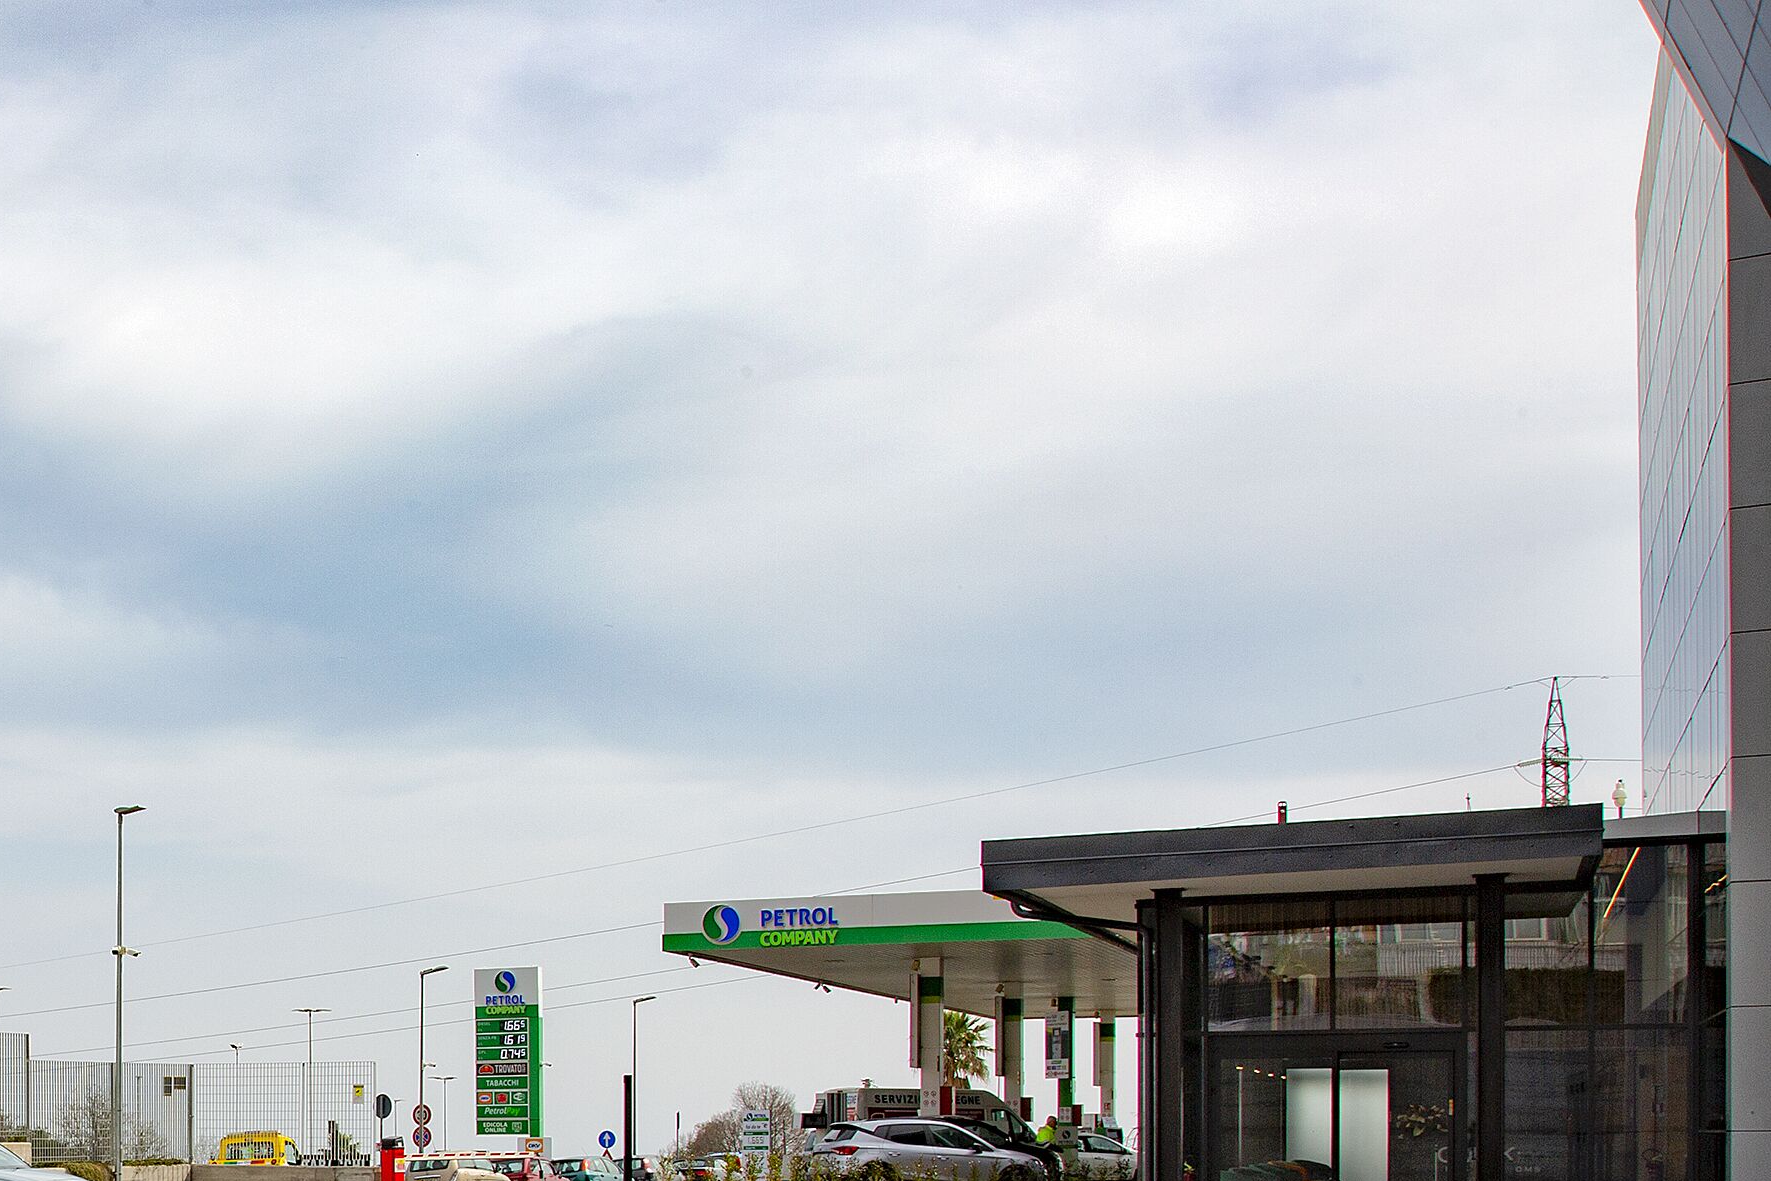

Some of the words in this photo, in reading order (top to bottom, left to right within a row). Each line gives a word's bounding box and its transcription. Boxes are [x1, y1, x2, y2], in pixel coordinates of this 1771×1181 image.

[760, 907, 840, 928] PETROL
[759, 929, 839, 948] COMPANY
[485, 995, 525, 1005] PETROL
[485, 1005, 526, 1015] COMPANY
[495, 1064, 521, 1074] TROVATO
[486, 1079, 519, 1087] TABACCHI
[874, 1094, 921, 1104] SERVIZI
[955, 1095, 981, 1105] EGNE
